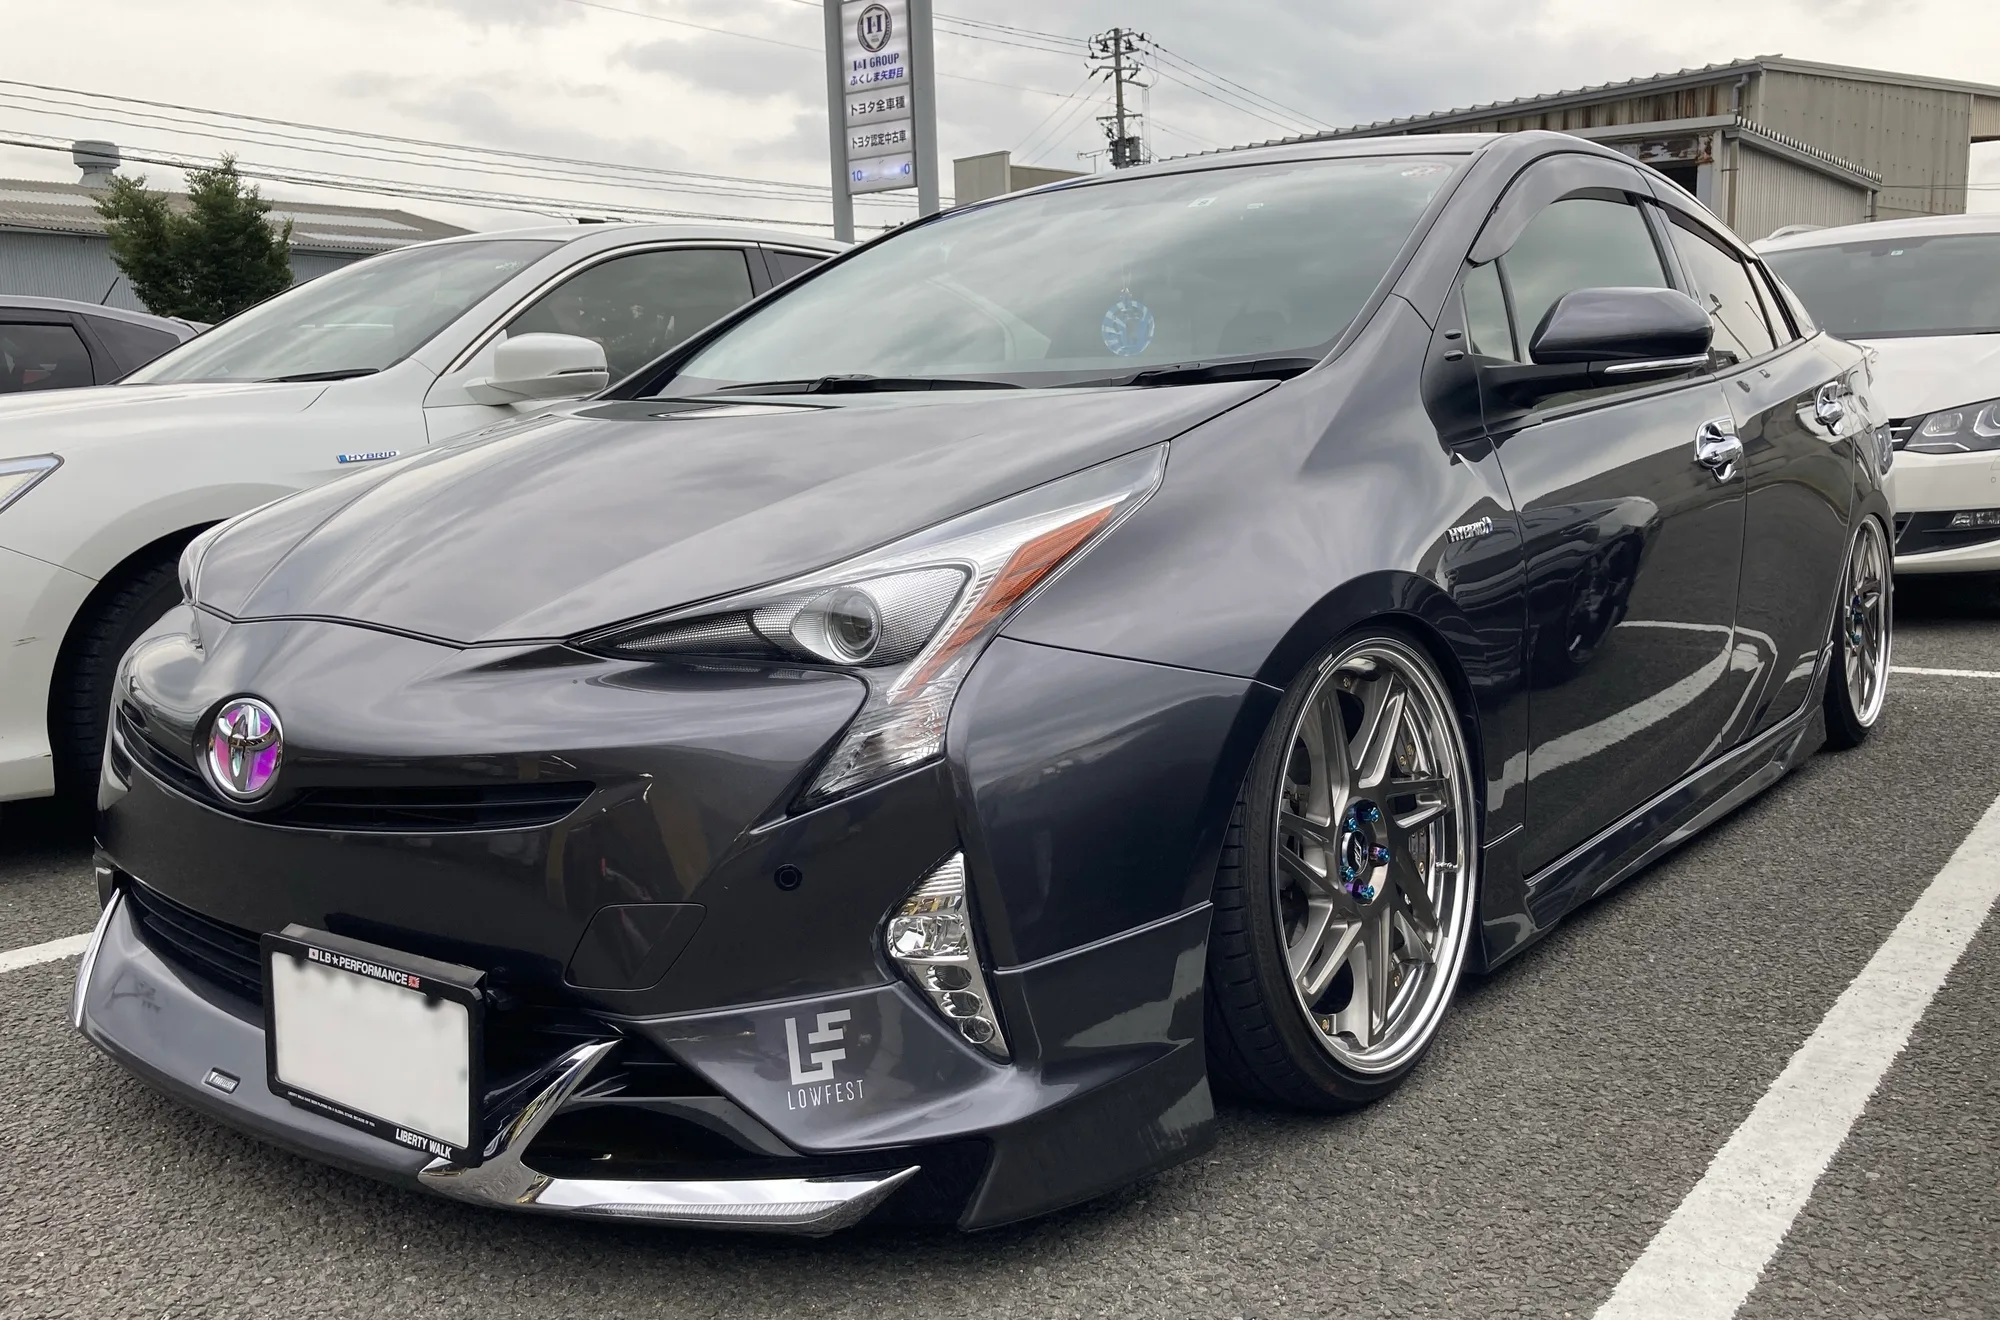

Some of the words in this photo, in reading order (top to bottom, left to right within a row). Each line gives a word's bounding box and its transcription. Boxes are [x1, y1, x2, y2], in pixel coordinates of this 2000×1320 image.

[869, 52, 899, 68] GROUP
[850, 66, 903, 86] ふくしま矢野目
[851, 95, 905, 117] トヨタ全車種
[852, 129, 907, 150] トヨタ認定中古車
[348, 450, 397, 461] HYBRID
[1448, 521, 1486, 543] HYBRID
[787, 1079, 864, 1111] LOWFEST
[395, 1127, 429, 1150] LIBERTY
[429, 1139, 453, 1159] WALK
